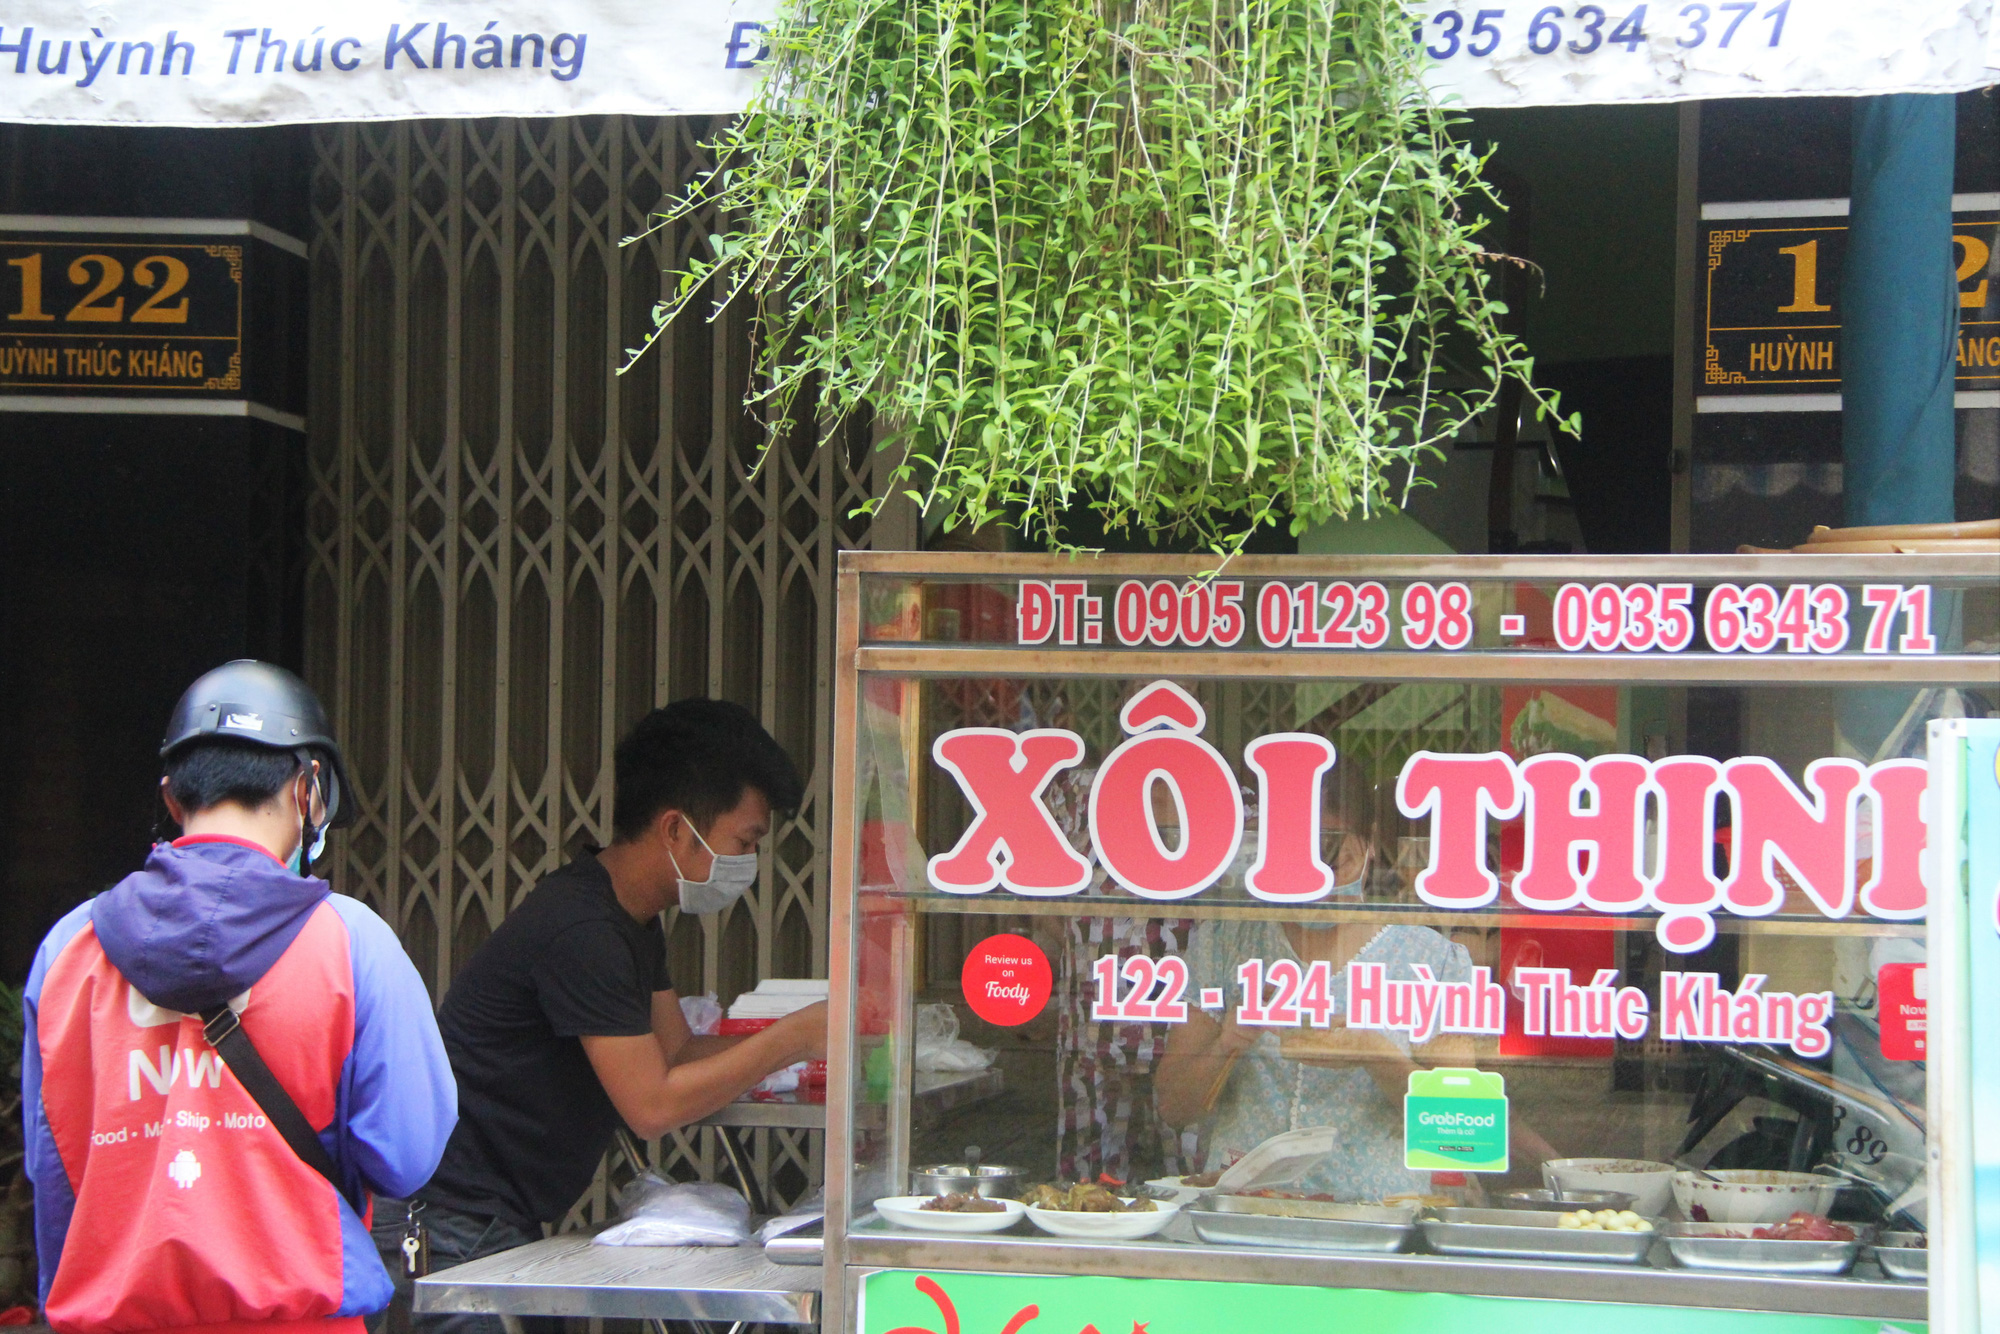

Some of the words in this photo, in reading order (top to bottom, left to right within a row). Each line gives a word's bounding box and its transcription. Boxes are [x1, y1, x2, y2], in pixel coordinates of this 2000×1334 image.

[1528, 4, 1648, 55] 634
[1676, 0, 1792, 48] 371
[0, 26, 194, 88] Huỳnh
[223, 26, 361, 76] Thúc
[383, 21, 588, 82] Kháng
[7, 252, 190, 323] 122
[0, 339, 58, 376] UỲNH
[63, 341, 122, 377] THÚC
[128, 342, 204, 378] KHÁNG
[1750, 334, 1833, 372] HUỲNH
[1955, 329, 2000, 367] ÁNG
[1017, 579, 1103, 645] ĐT:
[1114, 579, 1245, 647] 0905
[1257, 580, 1391, 648] 0123
[1402, 582, 1473, 650] 98
[1553, 582, 1694, 652] 0935
[1704, 583, 1850, 654] 6343
[1861, 584, 1936, 654] 71
[927, 679, 1337, 903] XÔI
[985, 954, 1019, 965] Review
[1021, 957, 1033, 965] us
[985, 981, 1031, 1006] Foody
[1092, 954, 1190, 1023] 122
[1236, 958, 1334, 1028] 124
[1346, 962, 1505, 1041] Huỳnh
[1515, 969, 1649, 1040] Thúc
[1660, 971, 1834, 1059] Kháng
[175, 1110, 211, 1132] Ship
[224, 1112, 267, 1129] Moto
[1418, 1111, 1496, 1127] GrabFood
